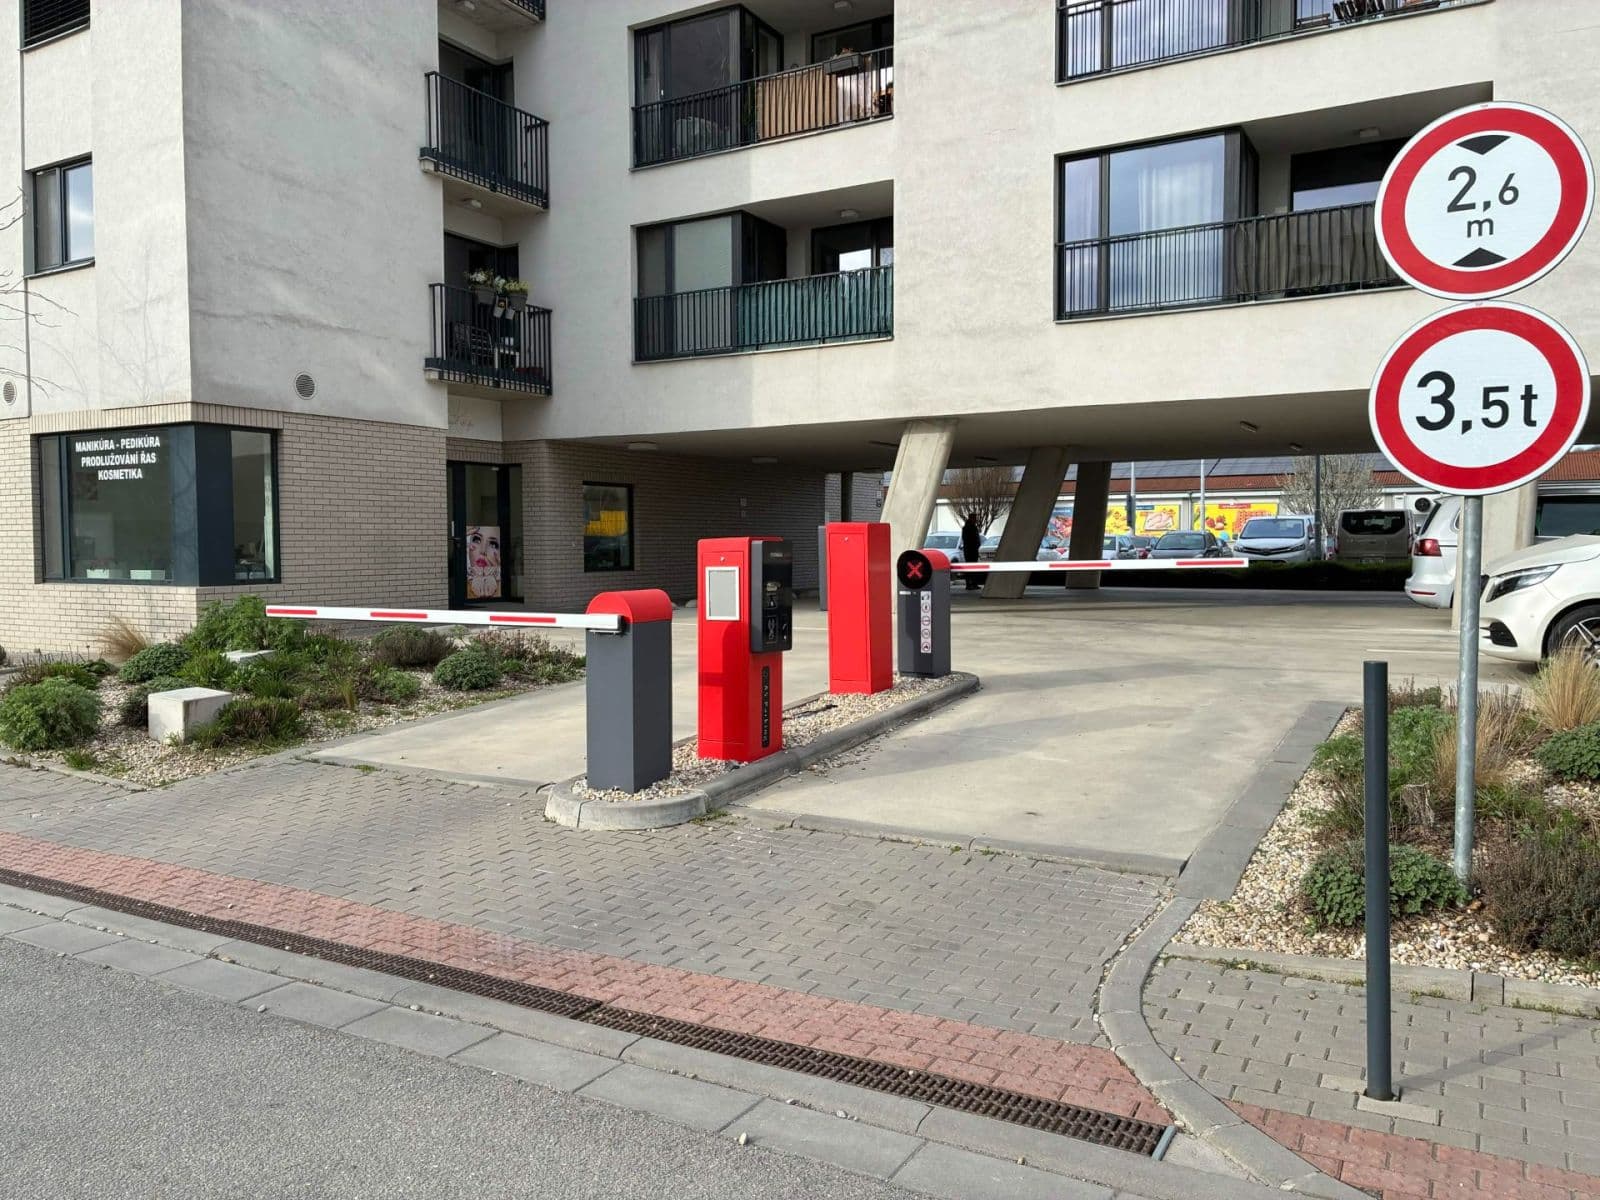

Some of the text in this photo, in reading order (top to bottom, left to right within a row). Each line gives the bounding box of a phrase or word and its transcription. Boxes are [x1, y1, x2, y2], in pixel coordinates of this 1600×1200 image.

[1446, 165, 1519, 213] 2,6
[1466, 215, 1494, 238] m
[1415, 370, 1538, 435] 3,5 t
[75, 438, 115, 452] MANIKÚRA
[120, 434, 160, 449] PEDIKÚRA
[81, 450, 156, 467] PRODLUŽOVÁNÍ ŘAS
[98, 468, 143, 480] KOSMETIKA
